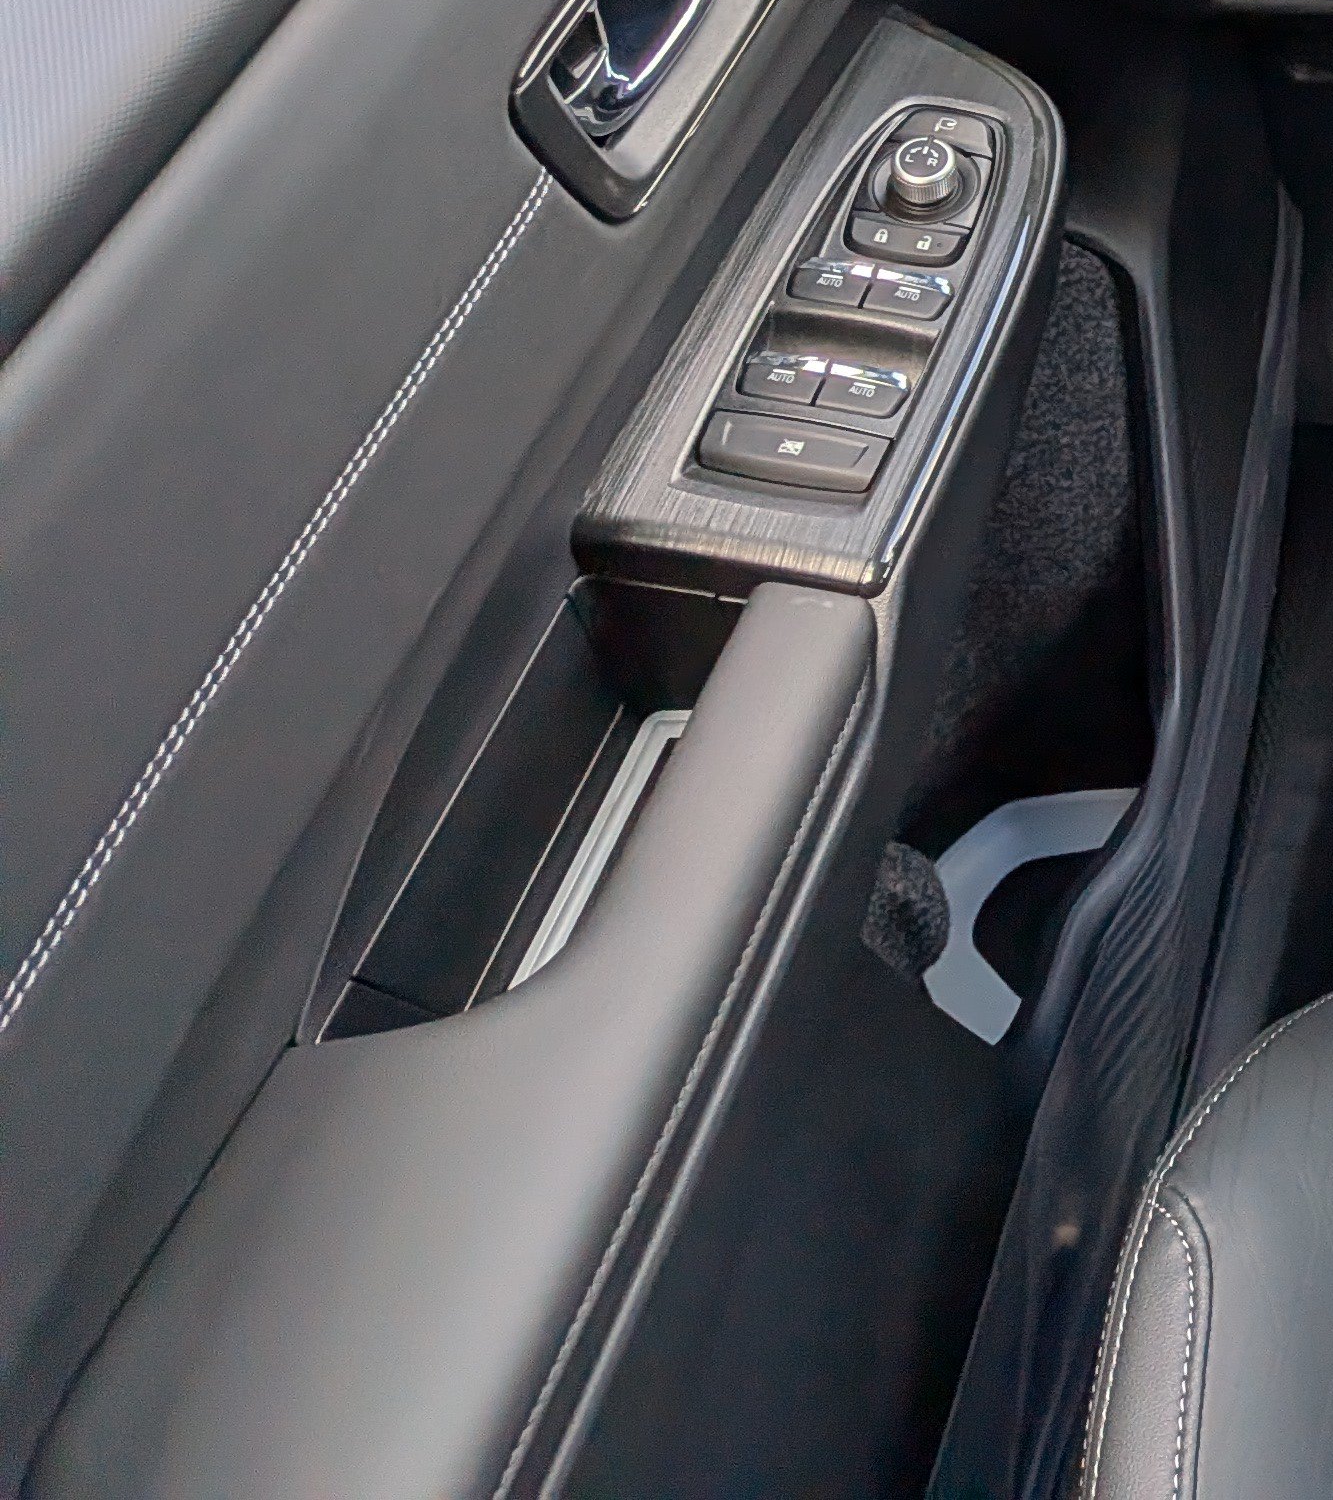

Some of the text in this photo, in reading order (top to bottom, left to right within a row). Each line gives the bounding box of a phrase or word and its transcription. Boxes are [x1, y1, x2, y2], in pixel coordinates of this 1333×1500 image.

[905, 153, 915, 163] L
[926, 157, 938, 167] R
[816, 276, 843, 288] AUTO
[894, 289, 920, 301] AUTO
[767, 372, 795, 384] AUTO
[848, 385, 876, 398] AUTO
